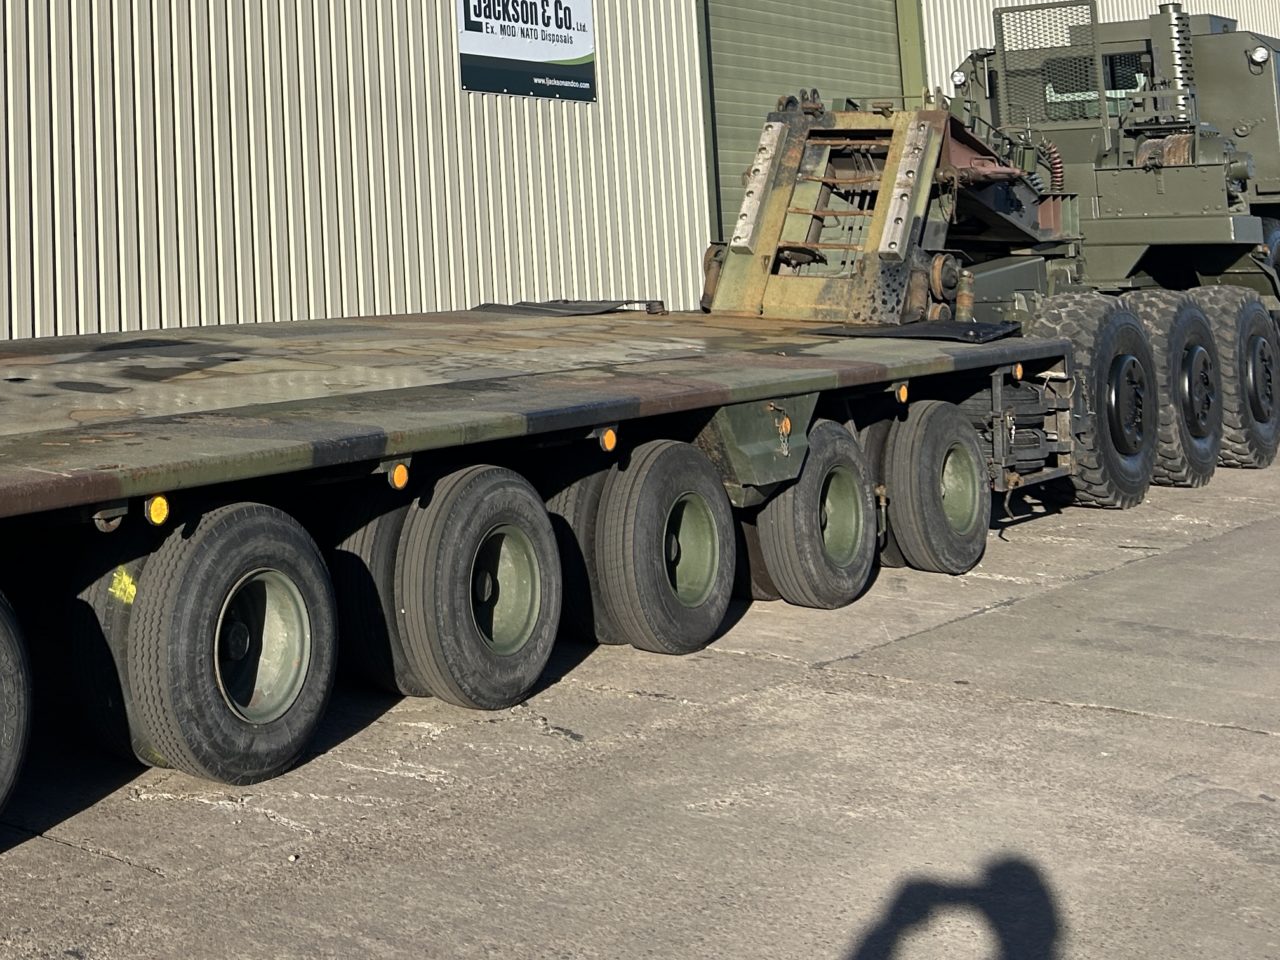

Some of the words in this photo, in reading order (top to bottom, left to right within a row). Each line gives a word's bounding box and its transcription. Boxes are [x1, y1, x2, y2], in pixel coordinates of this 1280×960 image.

[554, 0, 575, 31] Co.
[576, 22, 588, 33] Ltd.
[485, 22, 497, 35] Ex.
[541, 29, 574, 45] Disposals
